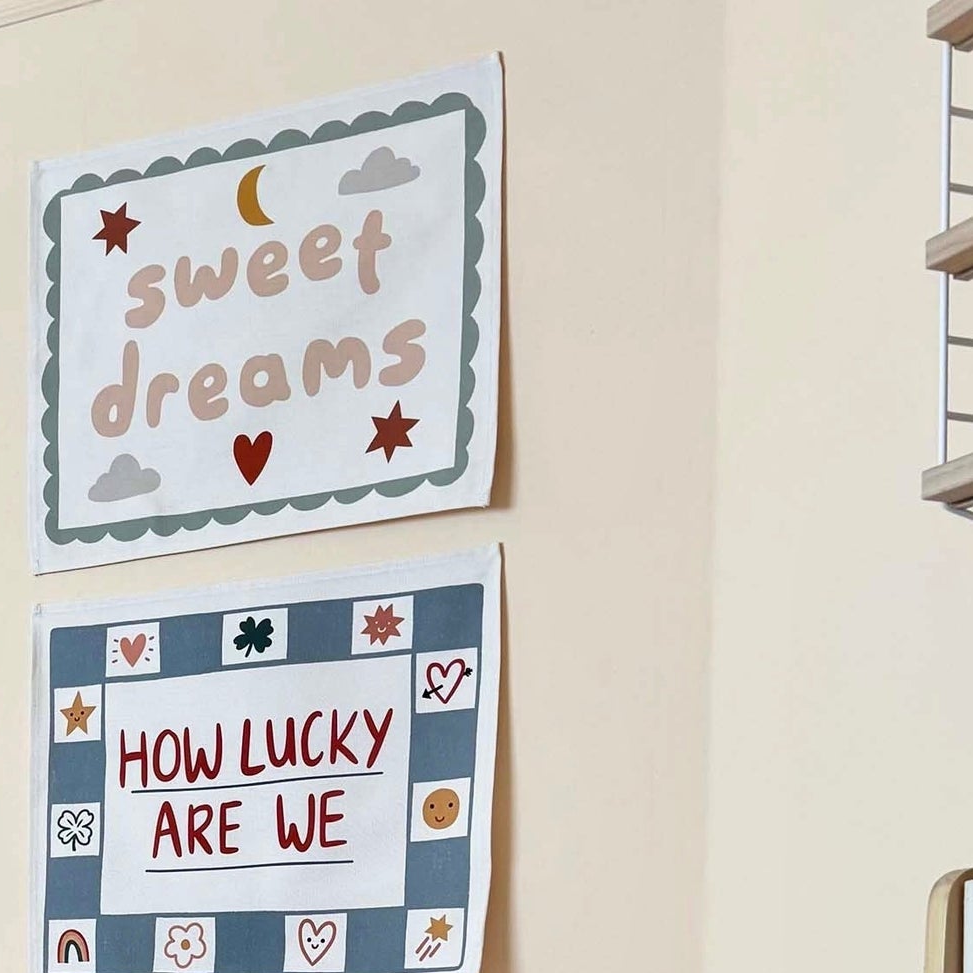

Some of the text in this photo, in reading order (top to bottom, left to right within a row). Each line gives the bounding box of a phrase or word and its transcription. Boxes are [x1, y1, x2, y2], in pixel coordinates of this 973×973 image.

[125, 209, 393, 329] sweet
[91, 319, 427, 438] dreams
[119, 708, 394, 788] HOW LUCKY
[152, 790, 348, 859] ARE WE
